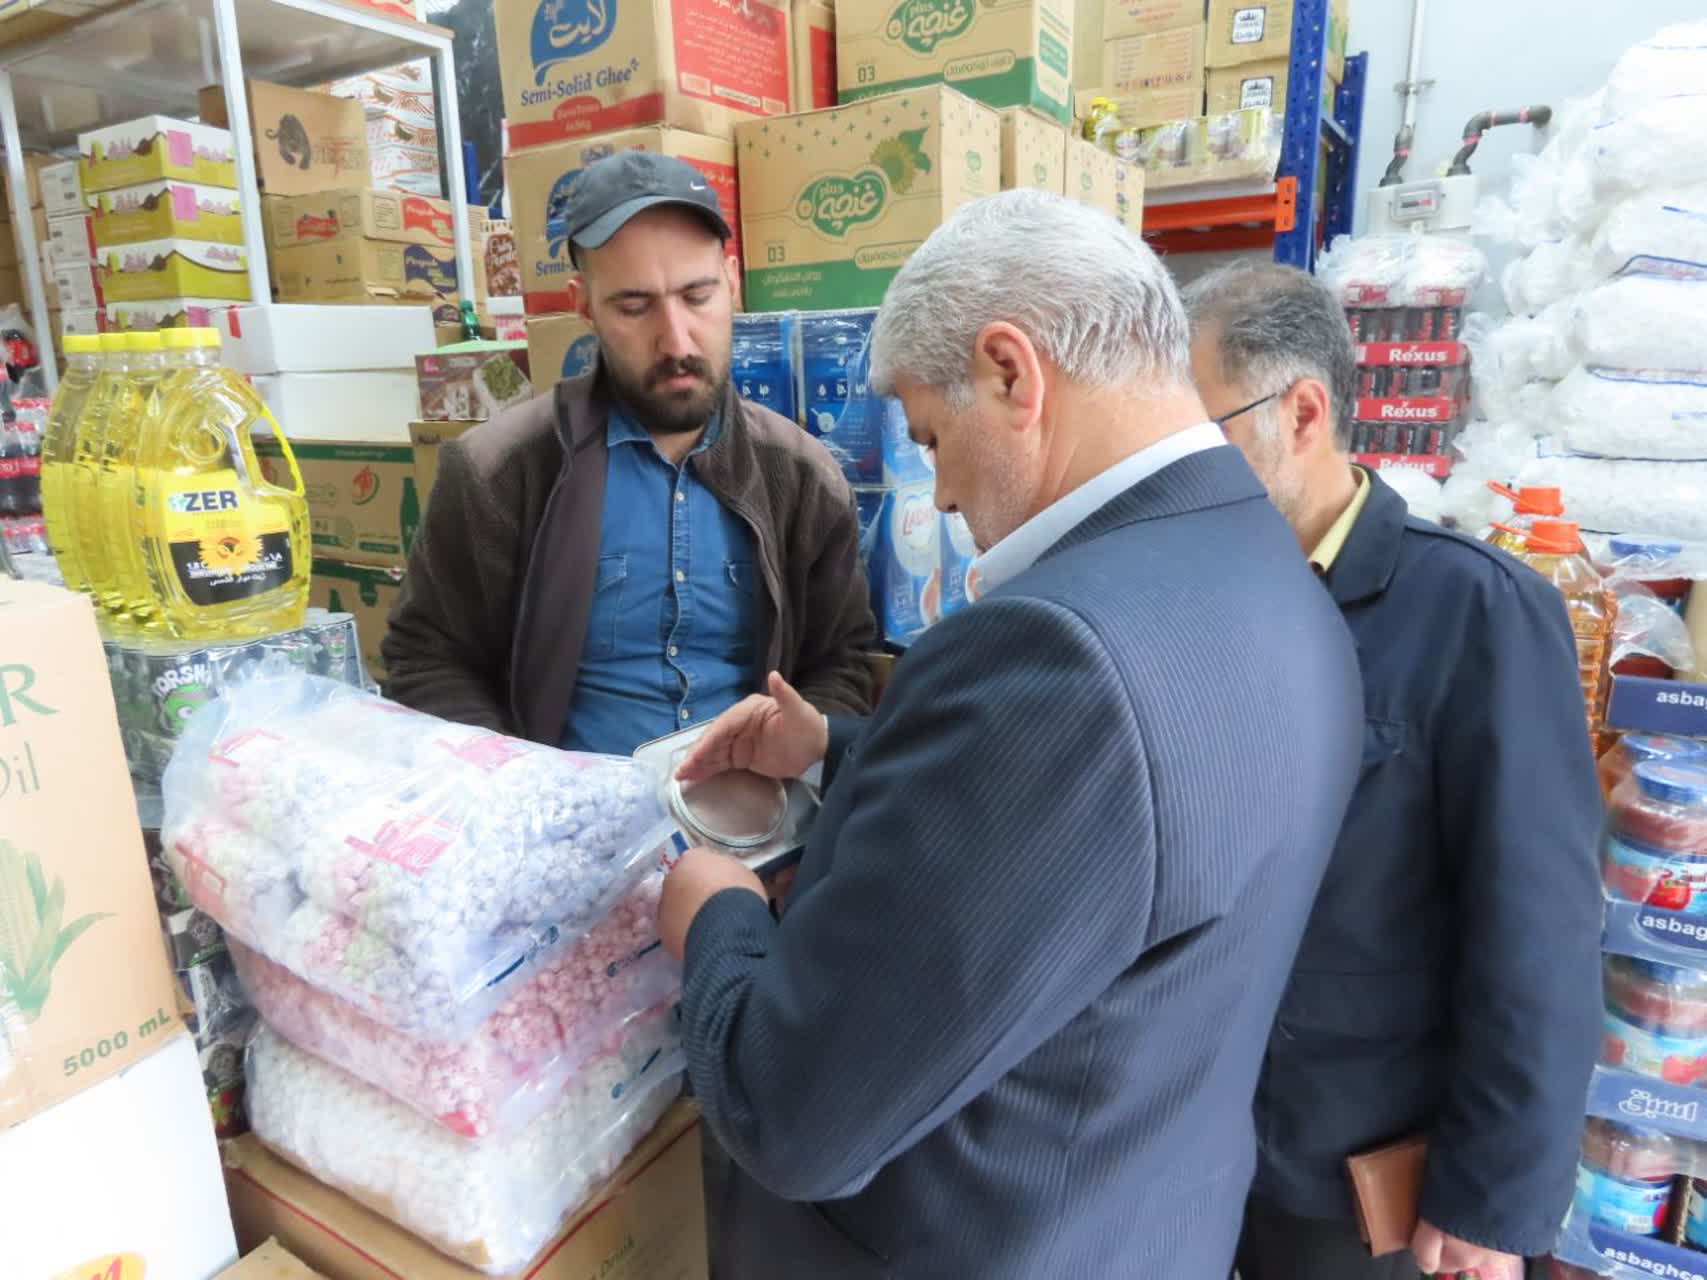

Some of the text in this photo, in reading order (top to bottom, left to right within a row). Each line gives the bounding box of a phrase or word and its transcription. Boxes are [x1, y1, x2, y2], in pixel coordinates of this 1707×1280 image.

[857, 65, 877, 84] 03
[520, 65, 633, 107] Semi-Solid Ghee
[767, 245, 786, 263] 03
[183, 490, 239, 512] ZER
[1655, 690, 1707, 711] asba
[63, 1008, 172, 1077] 5000 mL
